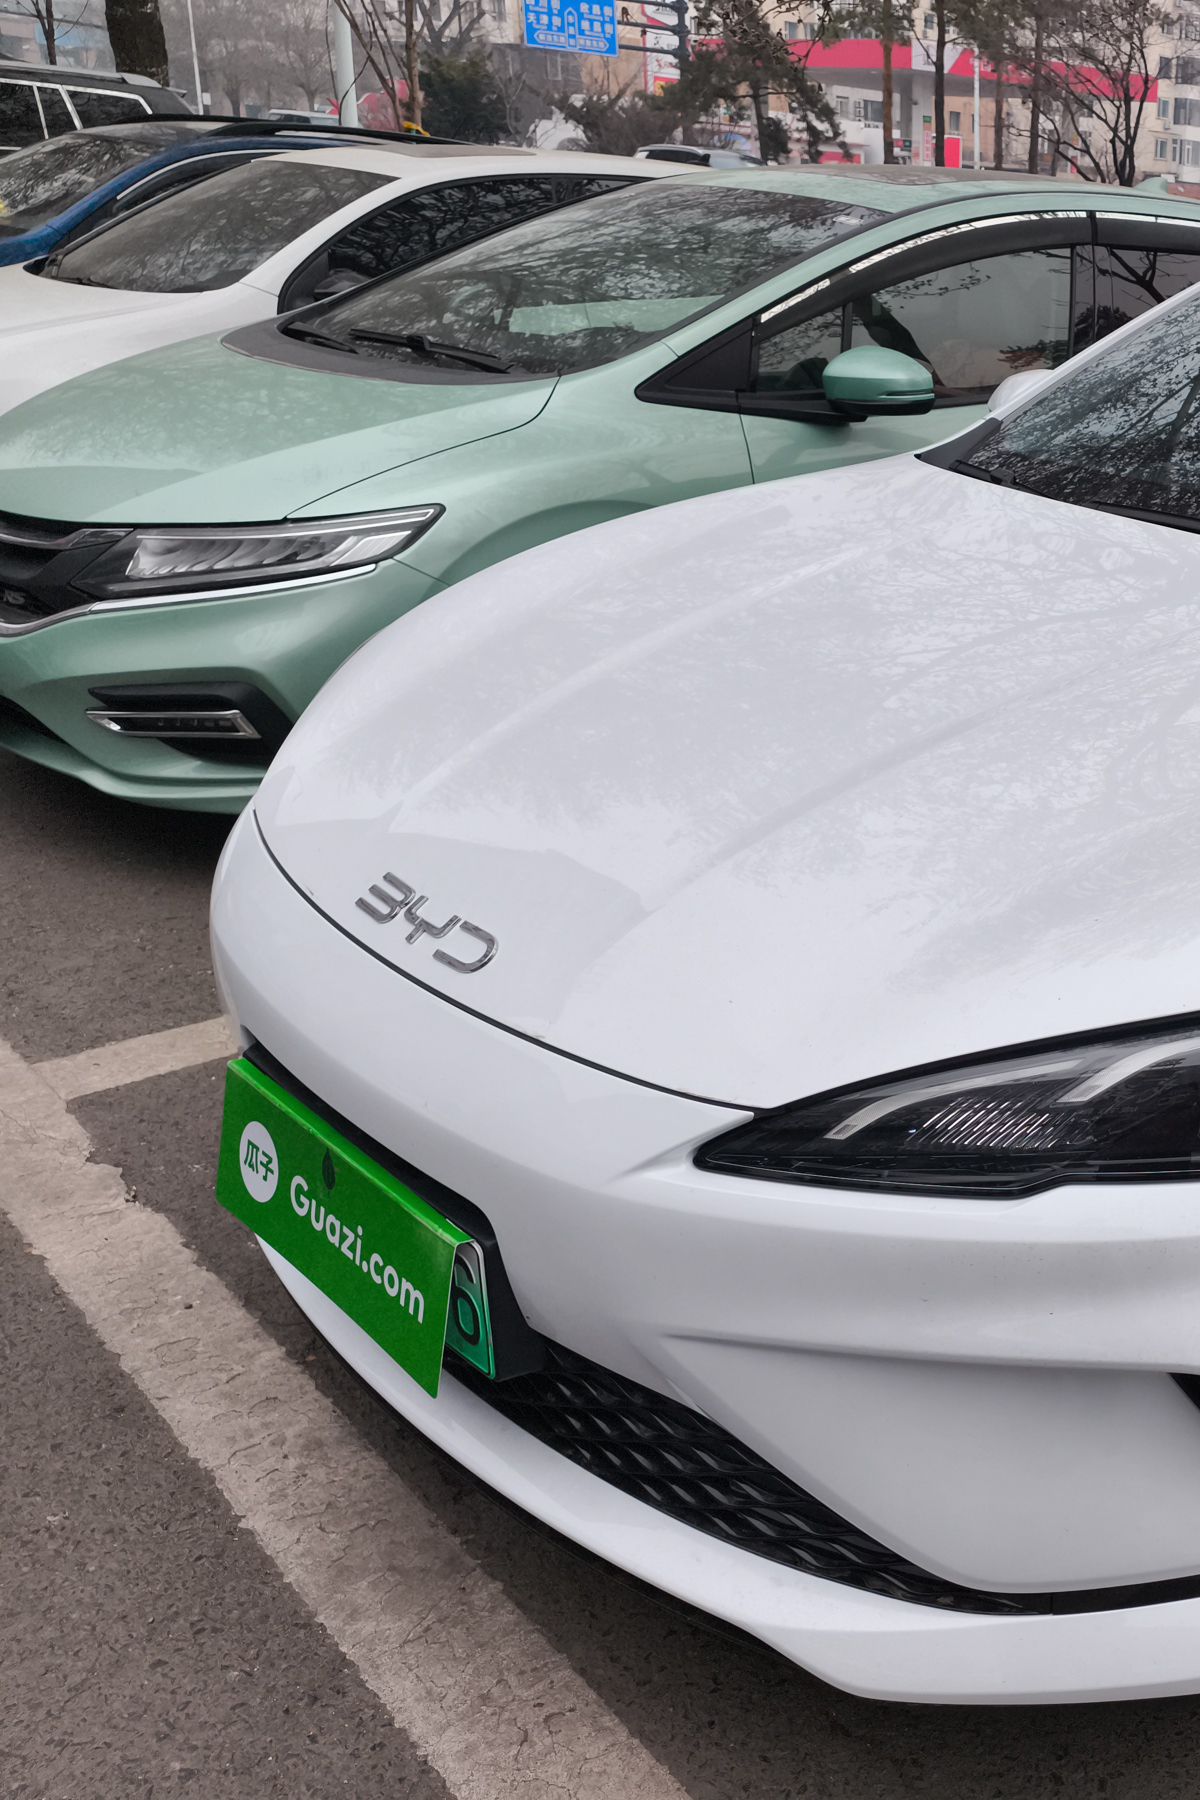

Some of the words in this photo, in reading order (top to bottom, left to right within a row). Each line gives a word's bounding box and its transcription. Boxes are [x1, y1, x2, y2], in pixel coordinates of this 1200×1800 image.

[354, 871, 499, 974] BYD
[243, 1138, 275, 1182] 瓜子
[290, 1175, 425, 1324] Guazi.com
